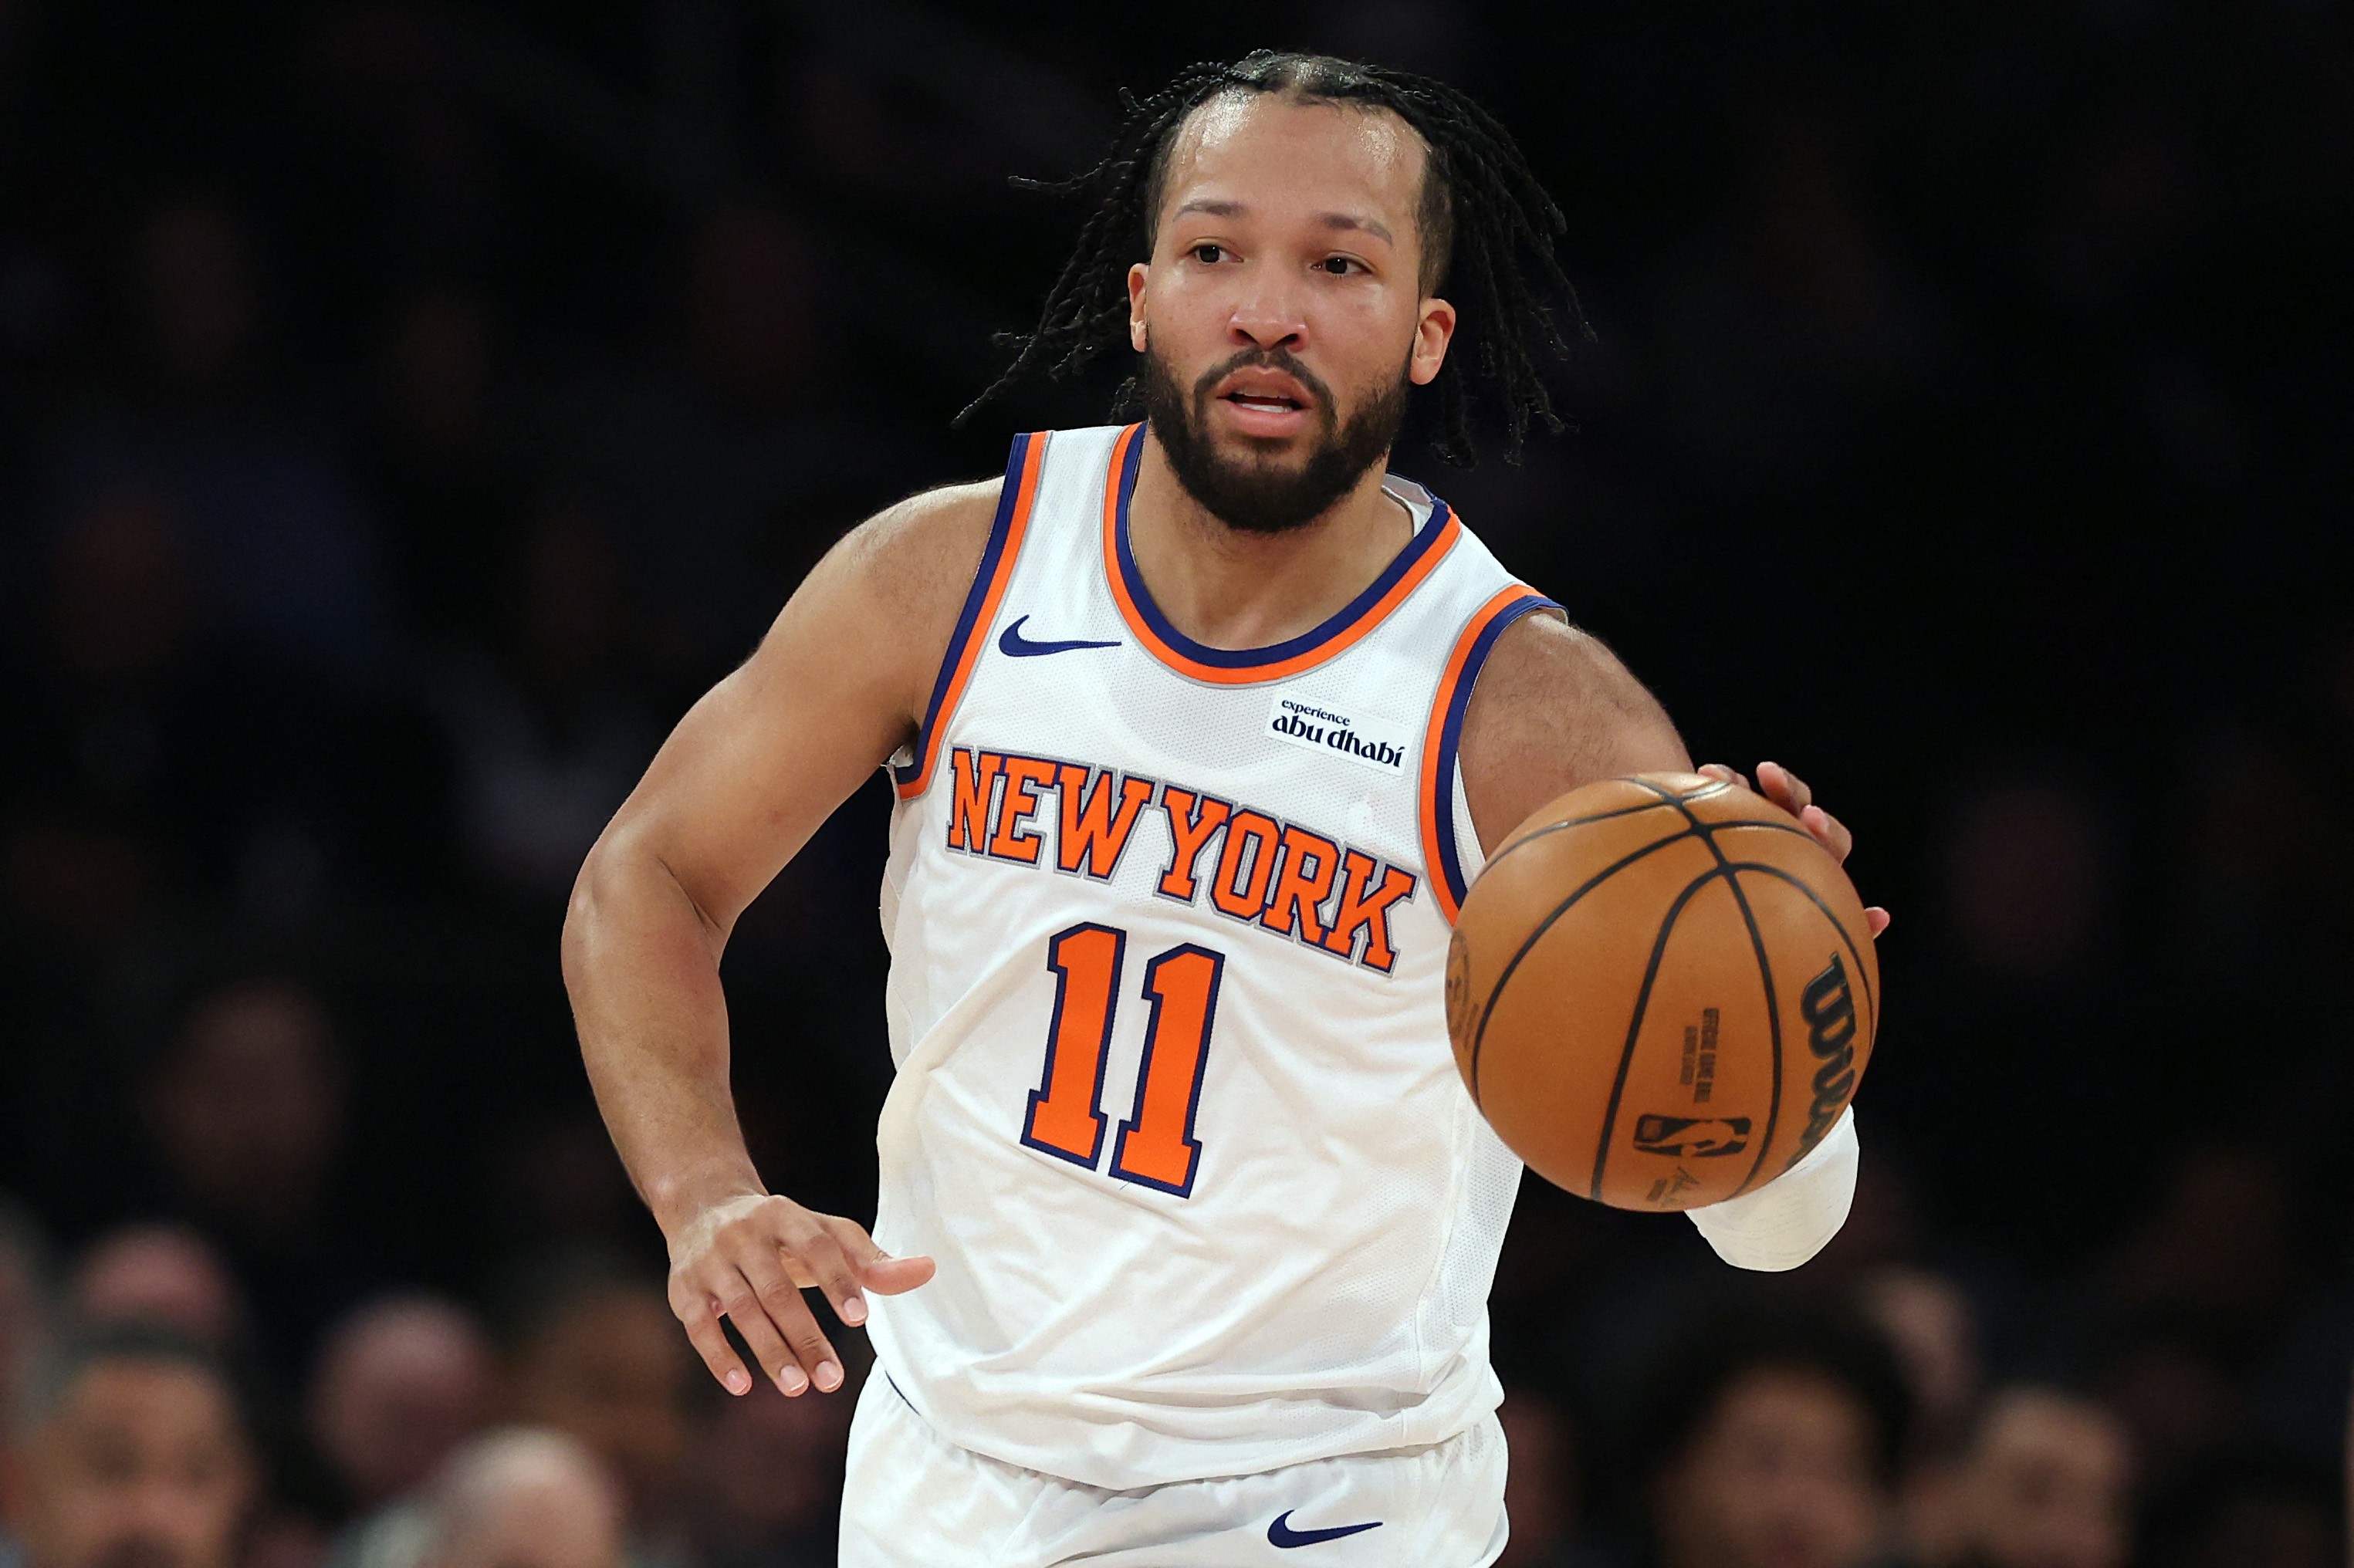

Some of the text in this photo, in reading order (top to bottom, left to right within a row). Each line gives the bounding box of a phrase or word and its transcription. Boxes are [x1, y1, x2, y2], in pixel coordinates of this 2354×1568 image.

[1272, 715, 1324, 743] abu
[946, 745, 1420, 978] NEW YORK
[1020, 921, 1226, 1199] 11
